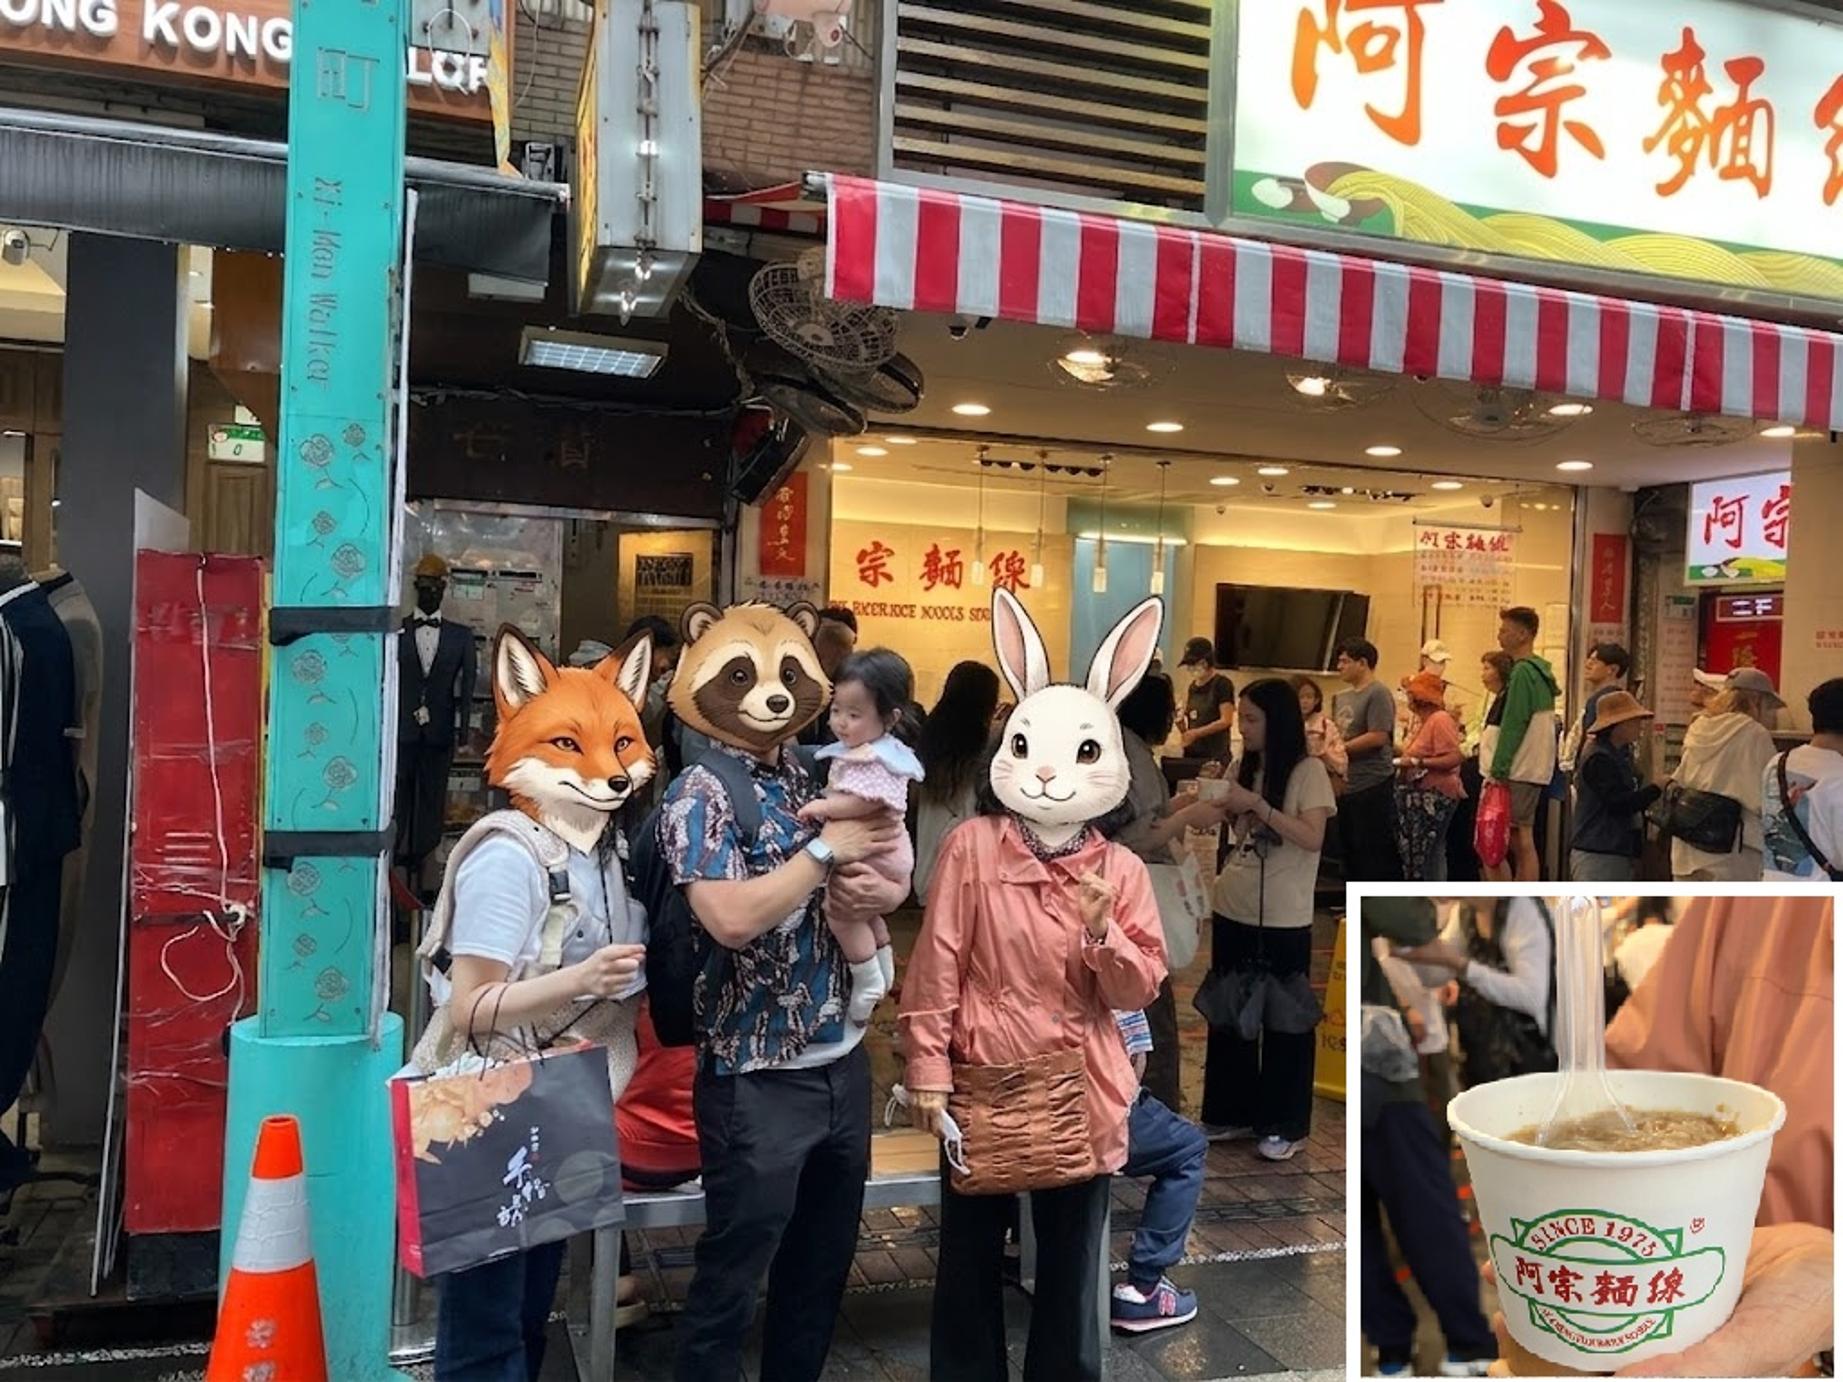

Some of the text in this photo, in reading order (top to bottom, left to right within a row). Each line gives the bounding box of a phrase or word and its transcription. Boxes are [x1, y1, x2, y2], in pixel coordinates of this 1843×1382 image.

[142, 1, 291, 62] KONG
[1531, 1217, 1660, 1257] SINCE 1975
[1516, 1256, 1686, 1307] 阿宗麵線
